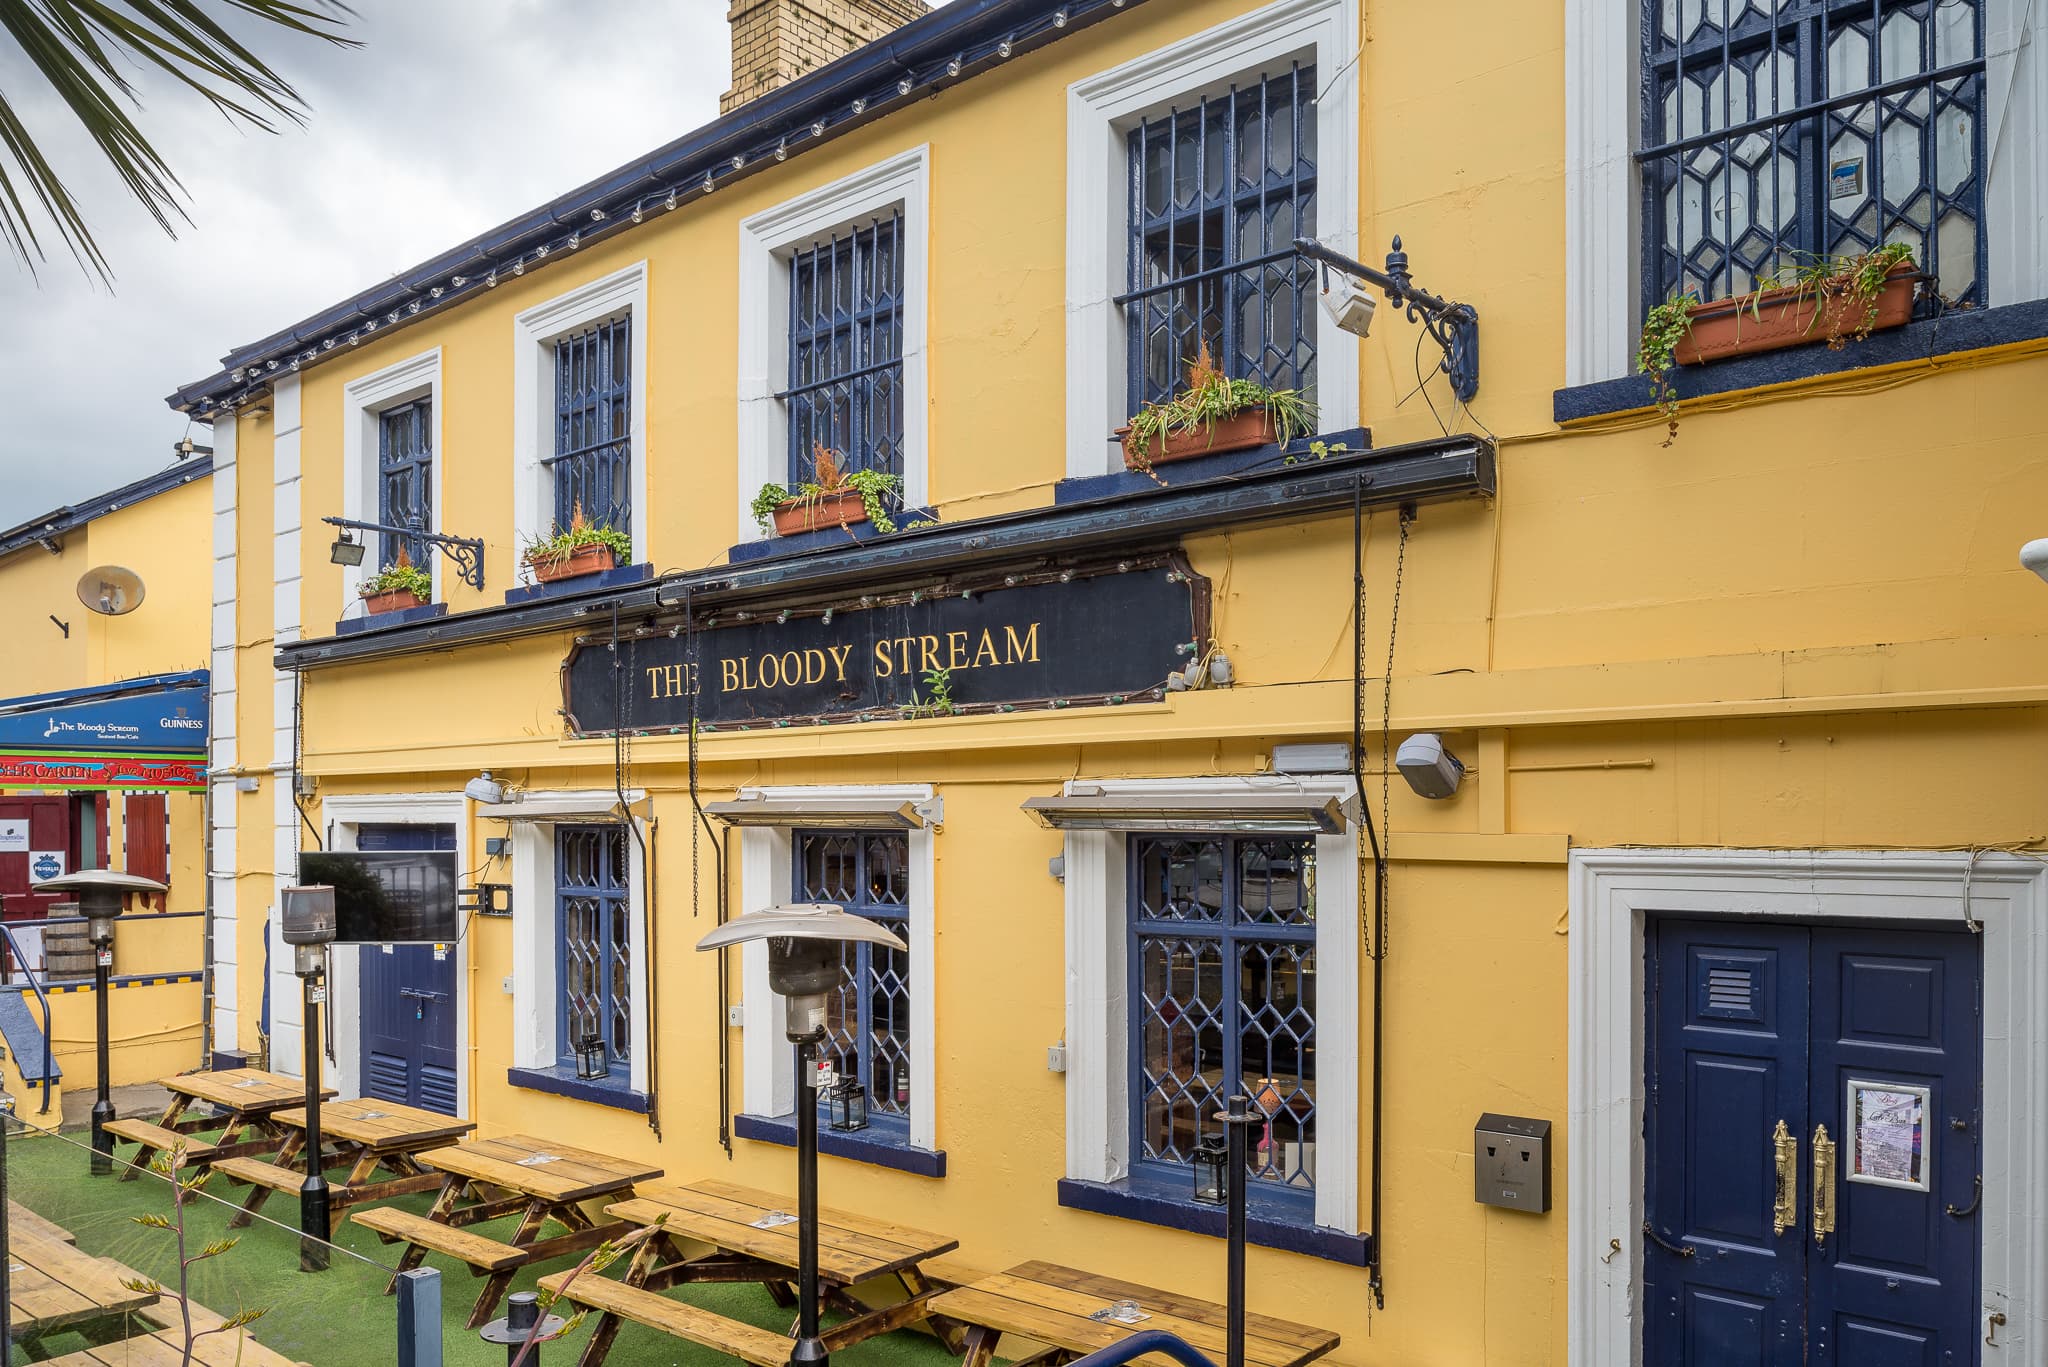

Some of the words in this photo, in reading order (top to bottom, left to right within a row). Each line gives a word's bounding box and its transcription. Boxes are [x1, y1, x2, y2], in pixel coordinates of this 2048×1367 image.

[646, 663, 701, 699] THE
[720, 644, 853, 692] BLOODY
[875, 622, 1041, 678] STREAM
[60, 722, 75, 731] The
[77, 722, 106, 733] Bloody
[160, 717, 203, 729] GUINNESS
[34, 764, 94, 778] GARDEN
